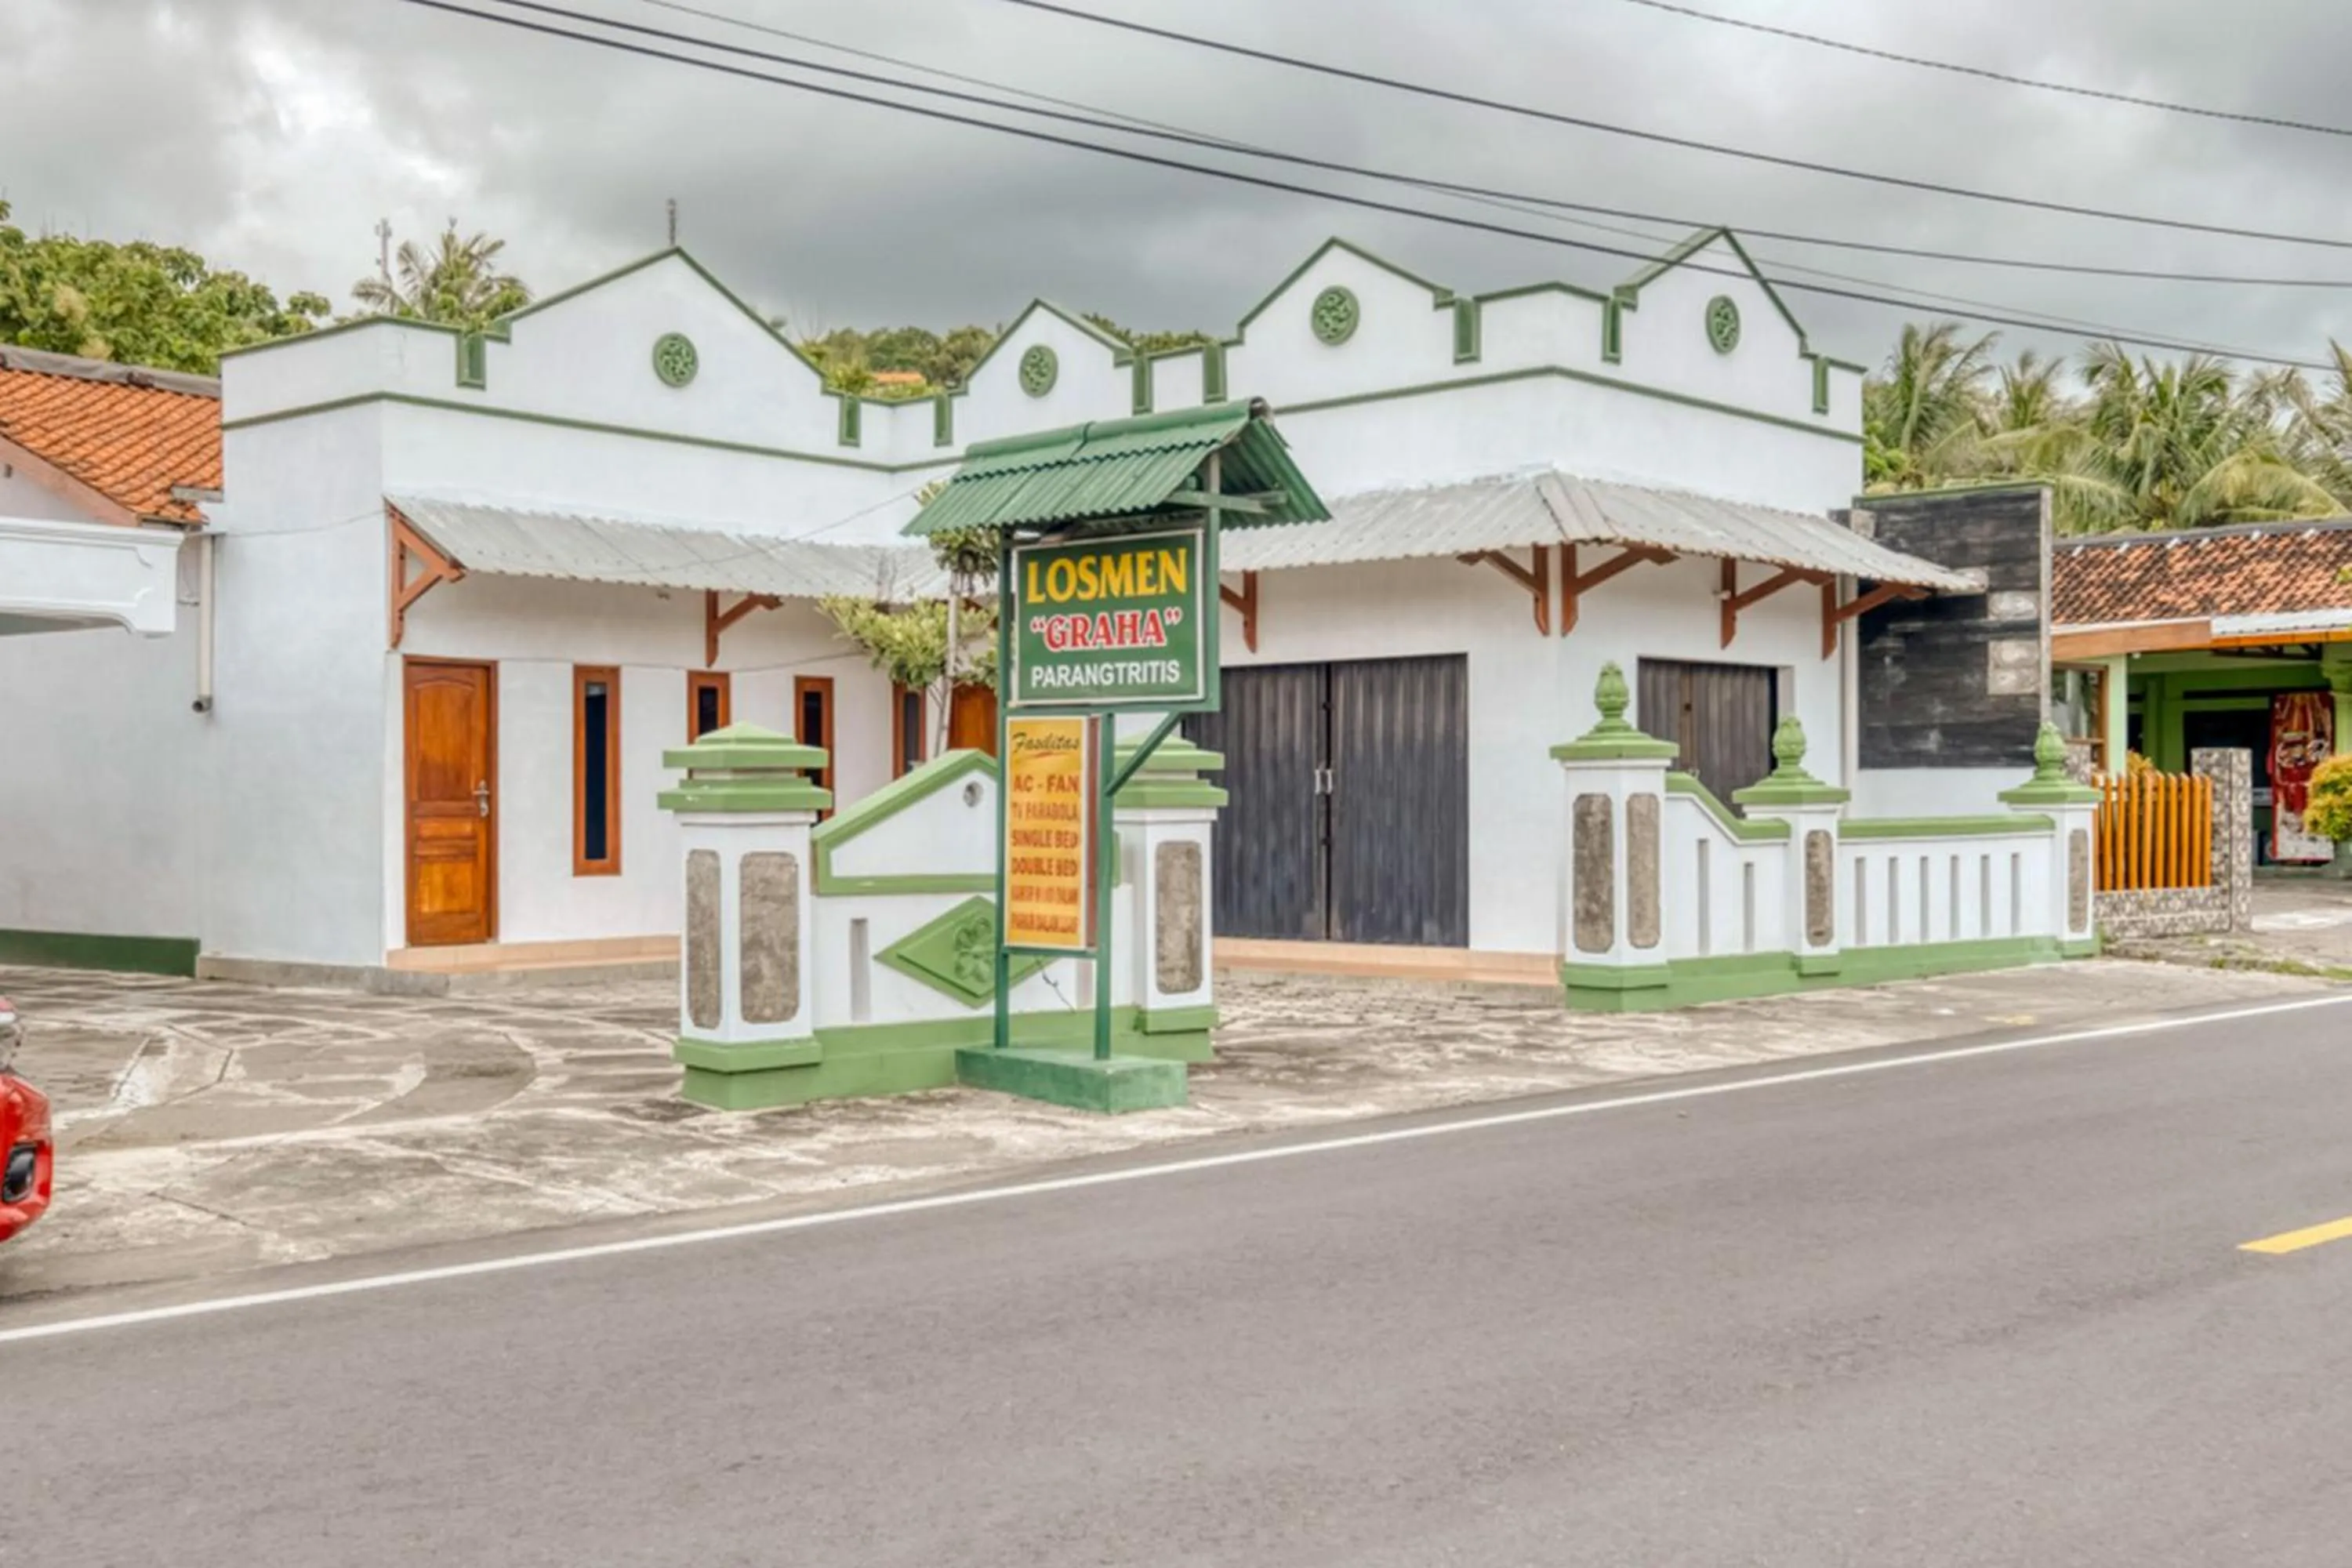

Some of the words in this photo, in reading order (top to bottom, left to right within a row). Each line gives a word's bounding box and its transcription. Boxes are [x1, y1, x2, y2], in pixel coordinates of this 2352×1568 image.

[1026, 548, 1188, 604] LOSMEN
[1029, 607, 1182, 652] “GRAHA”
[1031, 660, 1181, 688] PARANGTRITIS
[1014, 774, 1033, 792] AC
[1047, 774, 1080, 793] FAN
[1011, 829, 1052, 848] SINGLE
[1055, 830, 1078, 849] BED
[1011, 857, 1053, 876] DOUBLE
[1055, 858, 1078, 877] BED
